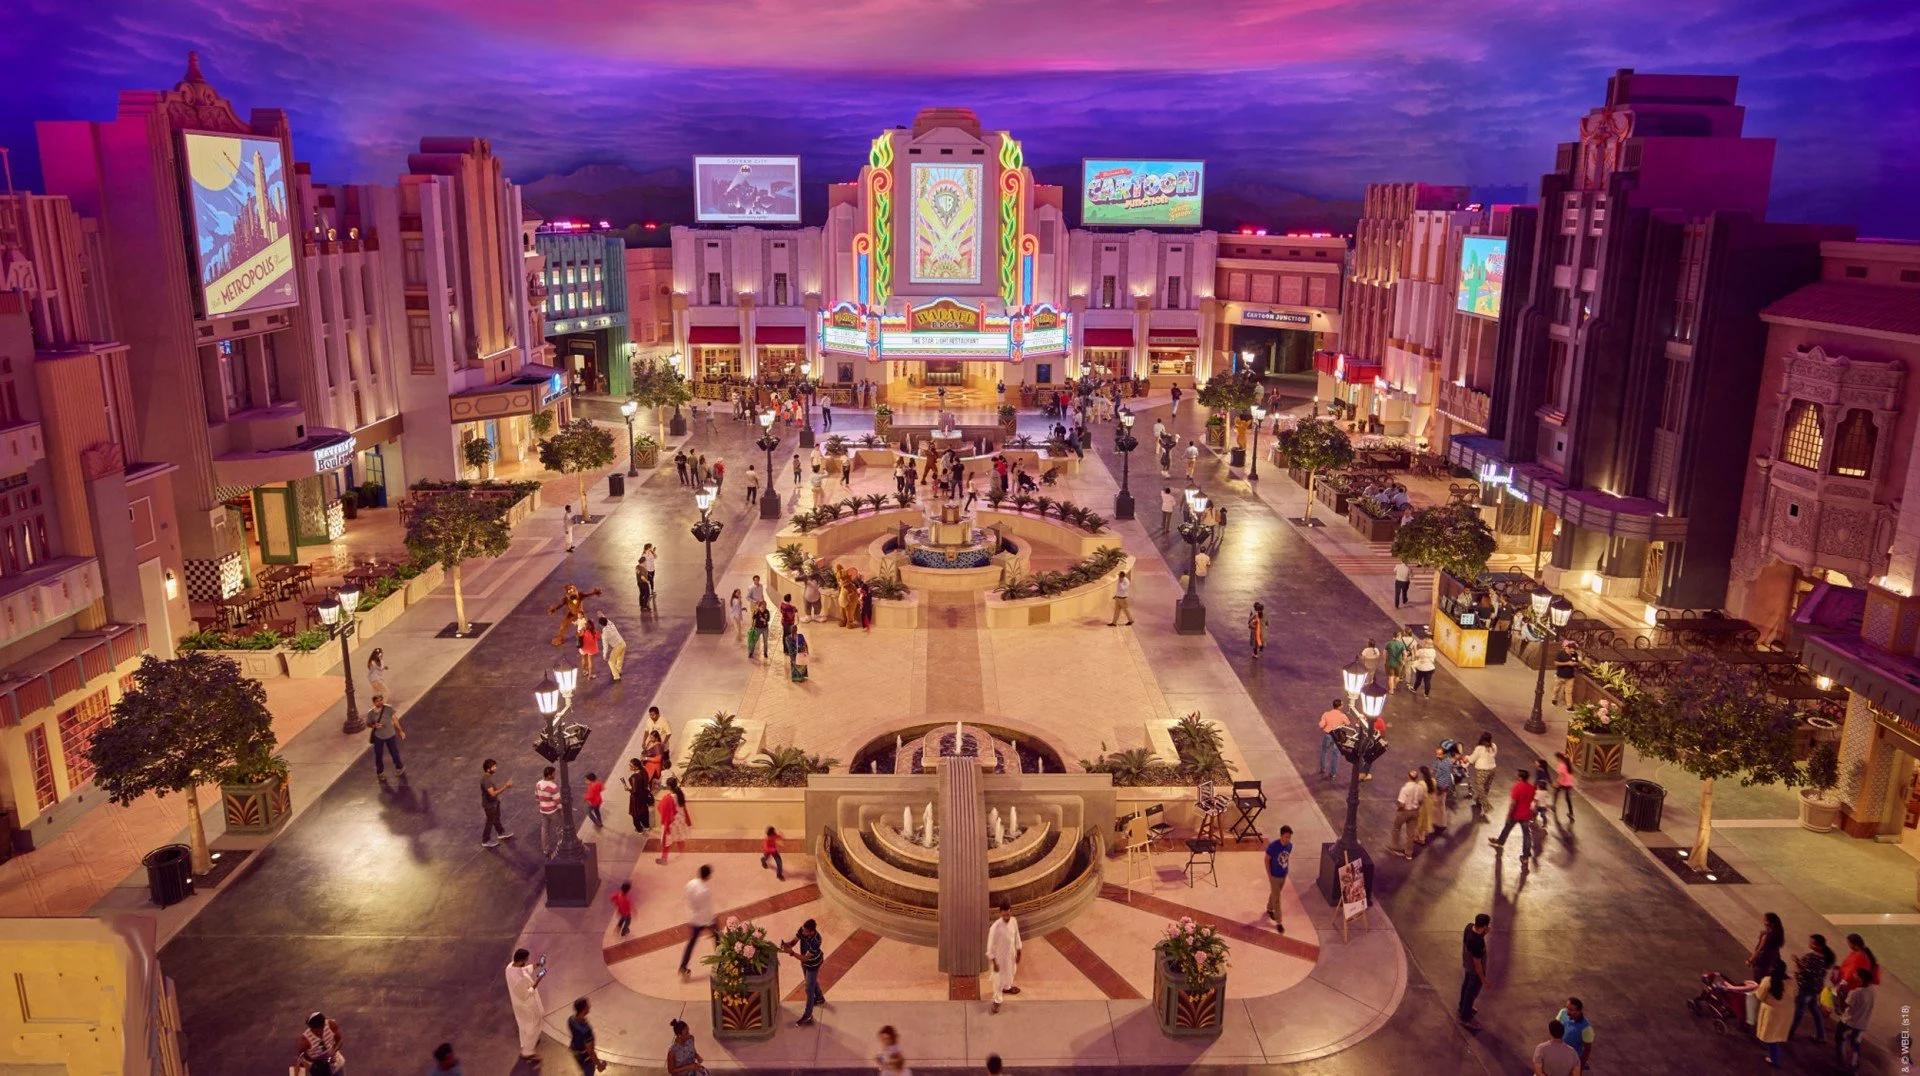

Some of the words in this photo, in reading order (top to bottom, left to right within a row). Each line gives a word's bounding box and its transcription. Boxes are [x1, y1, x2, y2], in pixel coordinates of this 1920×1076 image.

[1087, 170, 1198, 206] CARTOON
[221, 256, 275, 306] METROPOLIS
[915, 308, 976, 325] WARNER
[1246, 312, 1275, 320] CARTOON
[1275, 314, 1306, 322] JUNCTION
